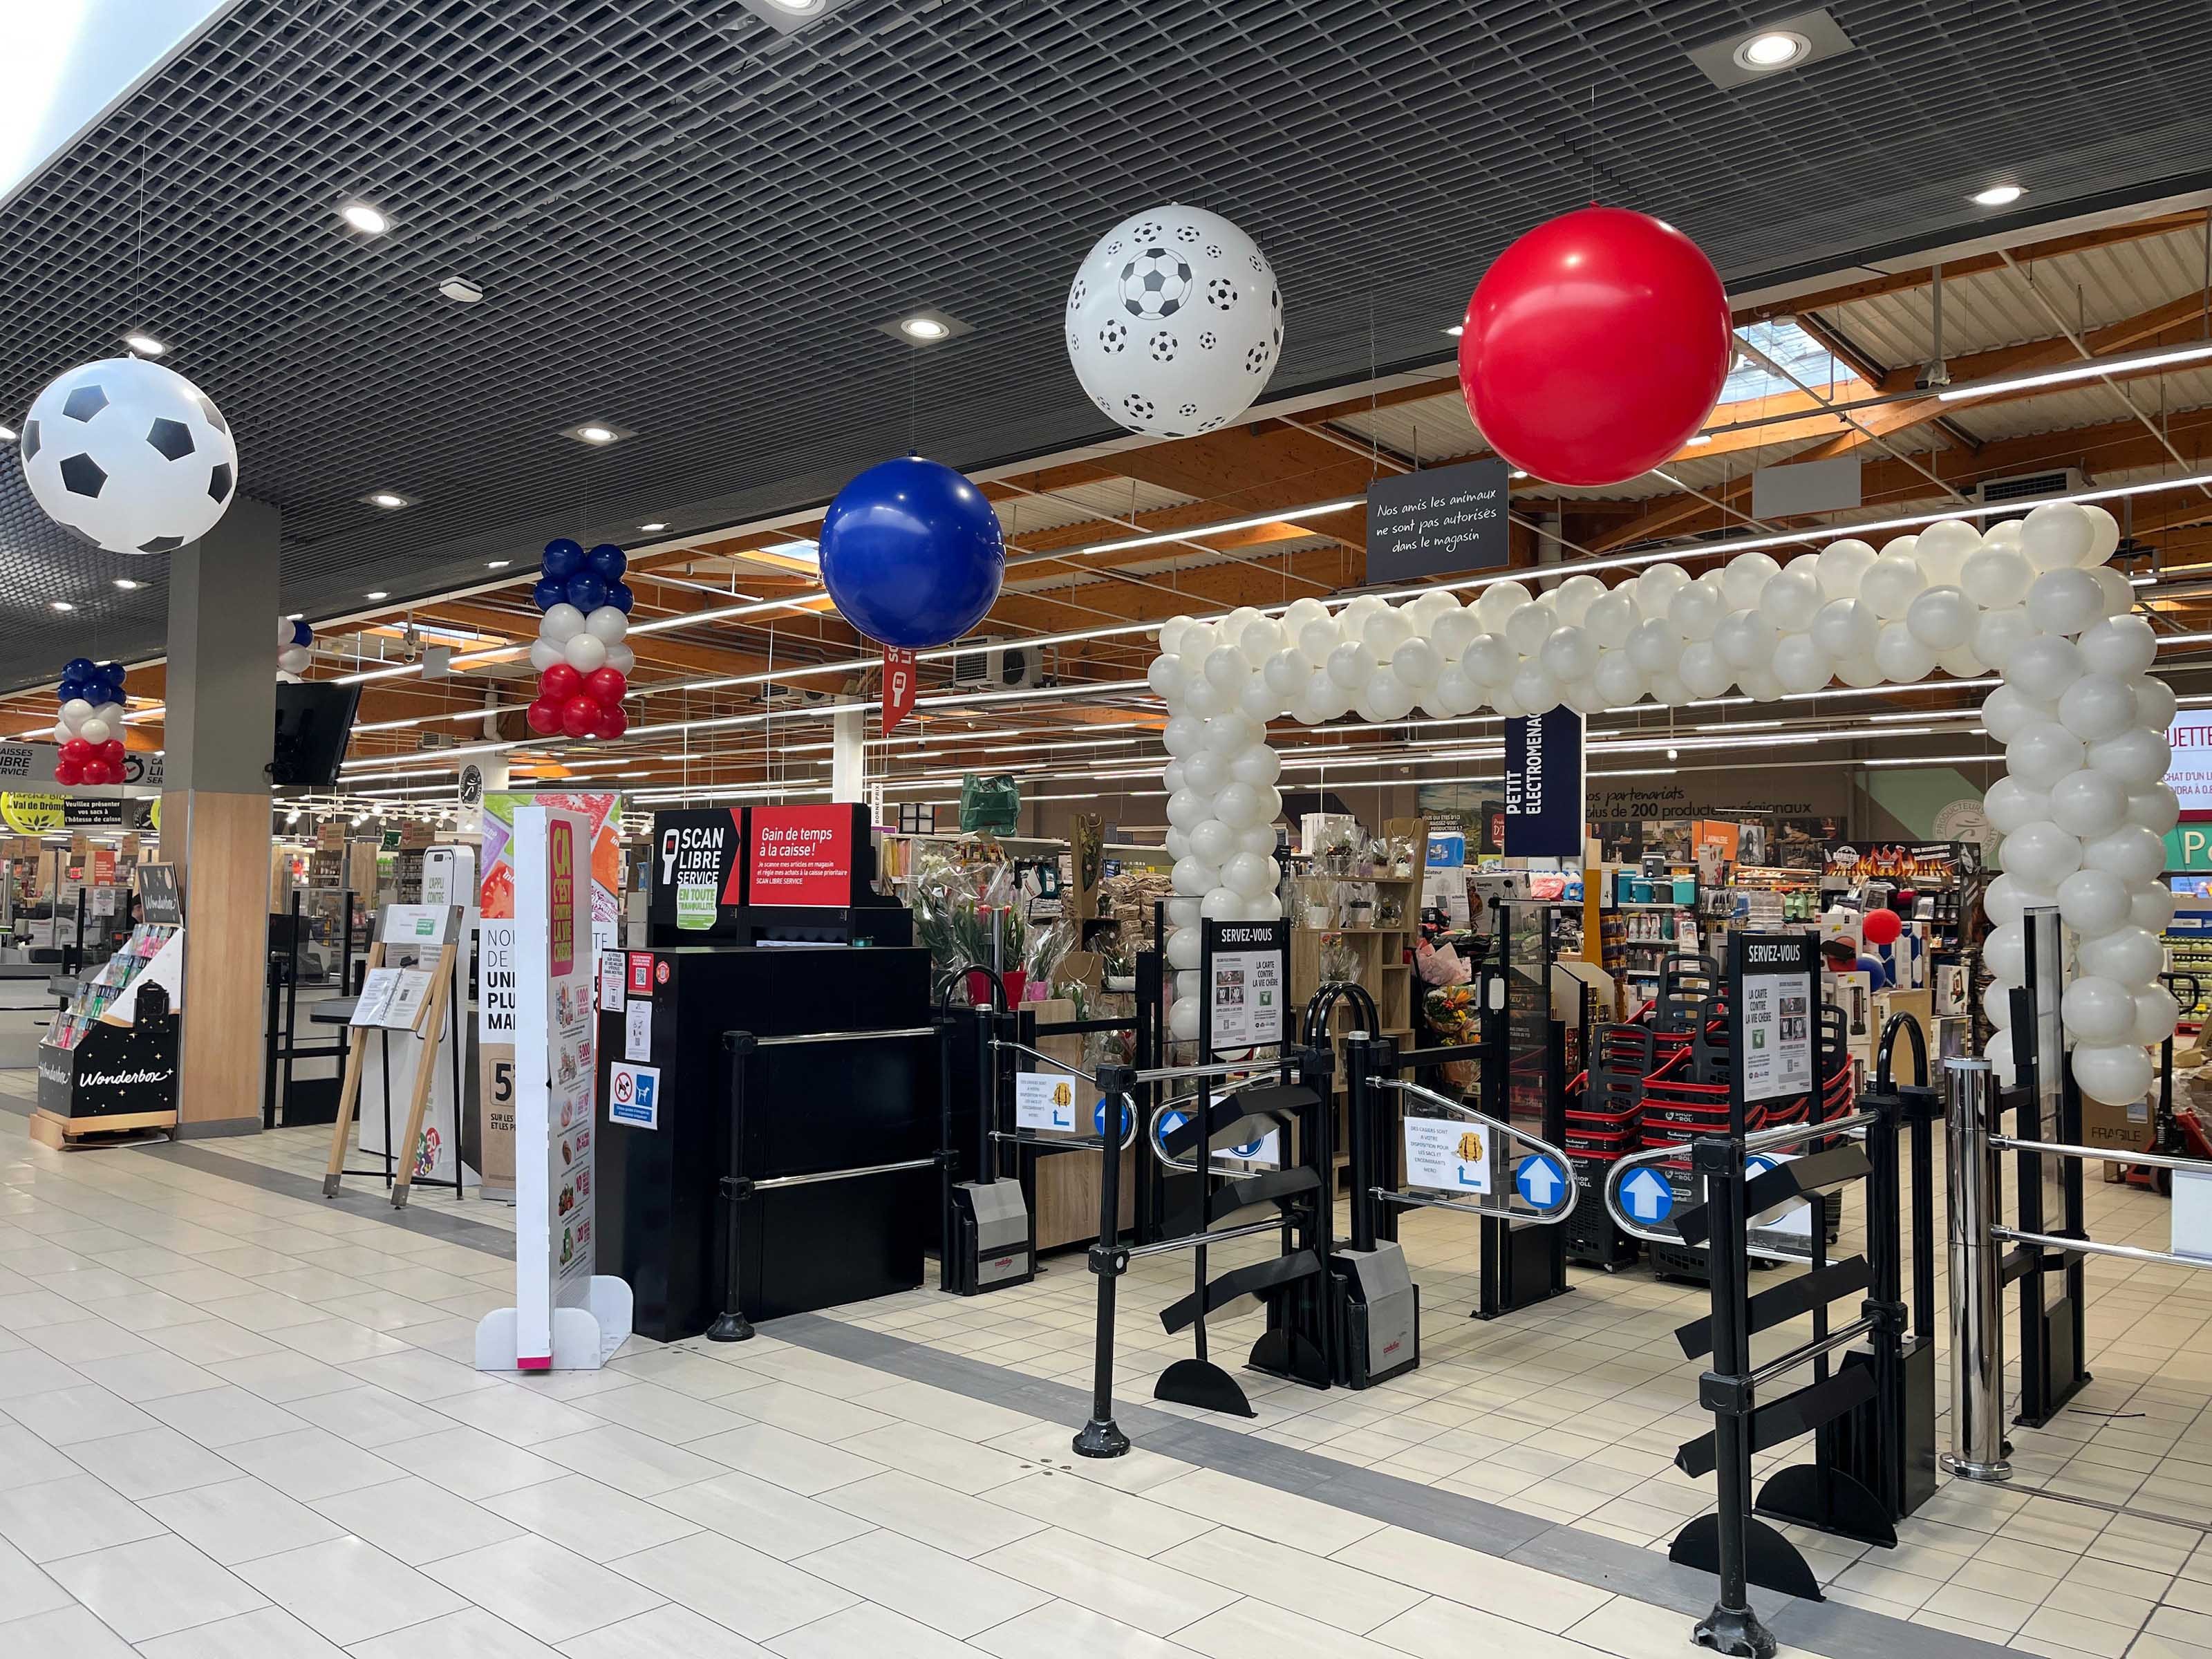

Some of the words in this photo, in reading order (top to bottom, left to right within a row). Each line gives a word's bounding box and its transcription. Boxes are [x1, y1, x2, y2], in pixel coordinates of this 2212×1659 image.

[1376, 504, 1398, 518] Nos
[1401, 498, 1427, 513] amis
[1430, 496, 1446, 509] les
[1450, 489, 1497, 505] animaux
[1376, 527, 1389, 536] ne
[1392, 520, 1416, 534] sont
[1418, 517, 1439, 534] pas
[1443, 507, 1497, 525] autorisés
[1391, 539, 1417, 553] dans
[1421, 536, 1430, 548] le
[1434, 528, 1479, 553] magasin
[0, 757, 32, 768] IBRE
[2186, 771, 2204, 781] D'UN
[1506, 770, 1521, 815] PETIT
[1586, 791, 1601, 801] os
[1604, 785, 1685, 807] partenariats
[13, 800, 26, 810] Val
[28, 800, 38, 810] de
[1611, 803, 1627, 817] de
[1631, 803, 1658, 817] 200
[681, 827, 724, 849] SCAN
[762, 827, 784, 841] Gain
[785, 826, 798, 841] de
[800, 827, 832, 843] temps
[760, 844, 767, 857] à
[768, 843, 778, 856] la
[679, 850, 722, 869] LIBRE
[814, 861, 834, 869] magasin
[677, 871, 720, 885] SERVICE
[823, 869, 847, 877] prioritaire
[678, 888, 690, 901] EN
[691, 888, 716, 901] TOUTE
[1221, 928, 1273, 943] SERVEZ-VOUS
[488, 950, 508, 968] DE
[1748, 944, 1801, 963] SERVEZ-VOUS
[1262, 960, 1275, 969] CARTE
[1257, 970, 1274, 979] CONTRE
[1253, 980, 1258, 988] LA
[1748, 989, 1753, 1000] LA
[1745, 1015, 1751, 1024] LA
[79, 1069, 168, 1087] Wonderbox
[495, 1062, 515, 1102] 5
[490, 1113, 502, 1122] SUR
[503, 1114, 514, 1123] LES
[490, 1122, 498, 1130] ET
[498, 1123, 509, 1131] LES
[2091, 1127, 2141, 1143] FRAGILE
